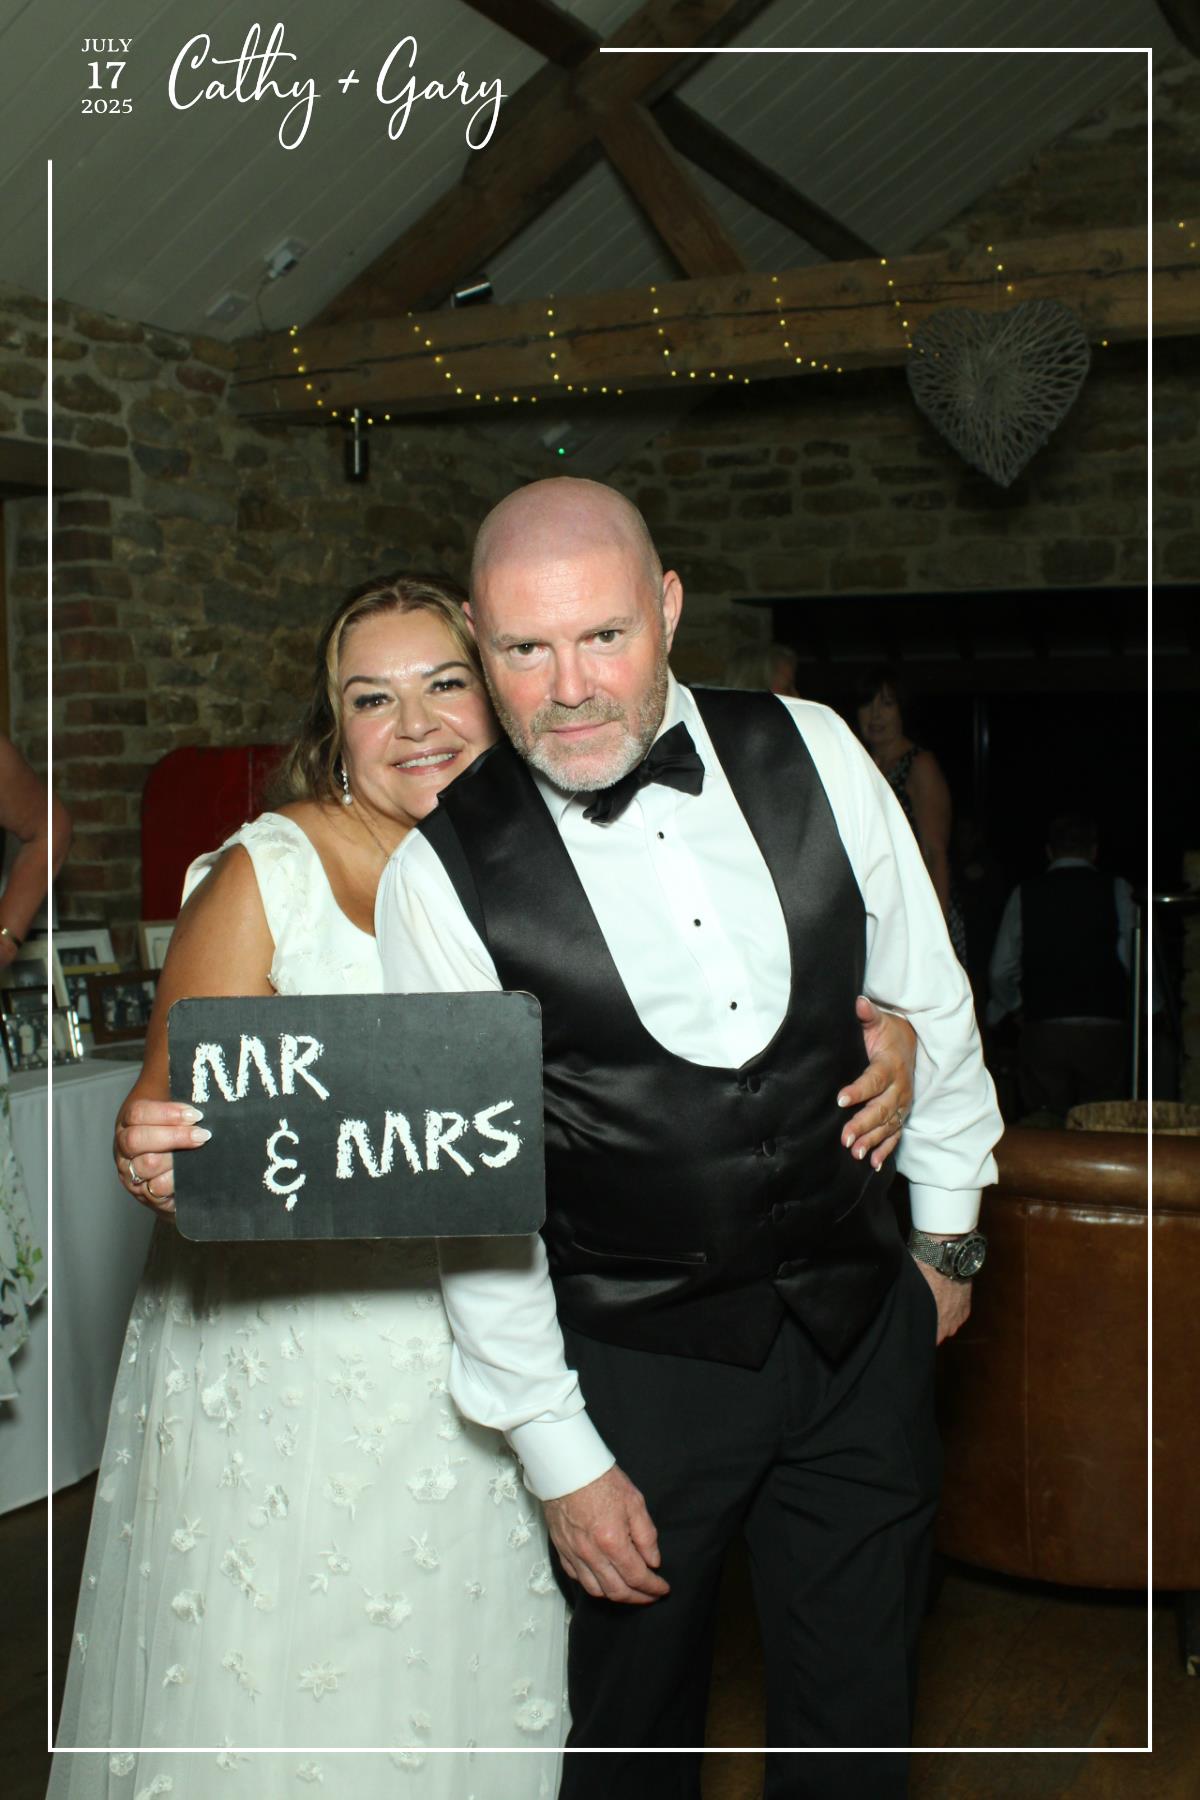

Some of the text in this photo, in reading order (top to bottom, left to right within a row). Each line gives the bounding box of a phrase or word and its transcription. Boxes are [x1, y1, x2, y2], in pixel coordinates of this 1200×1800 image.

[191, 1032, 331, 1104] MR
[262, 1099, 525, 1212] & MRS
